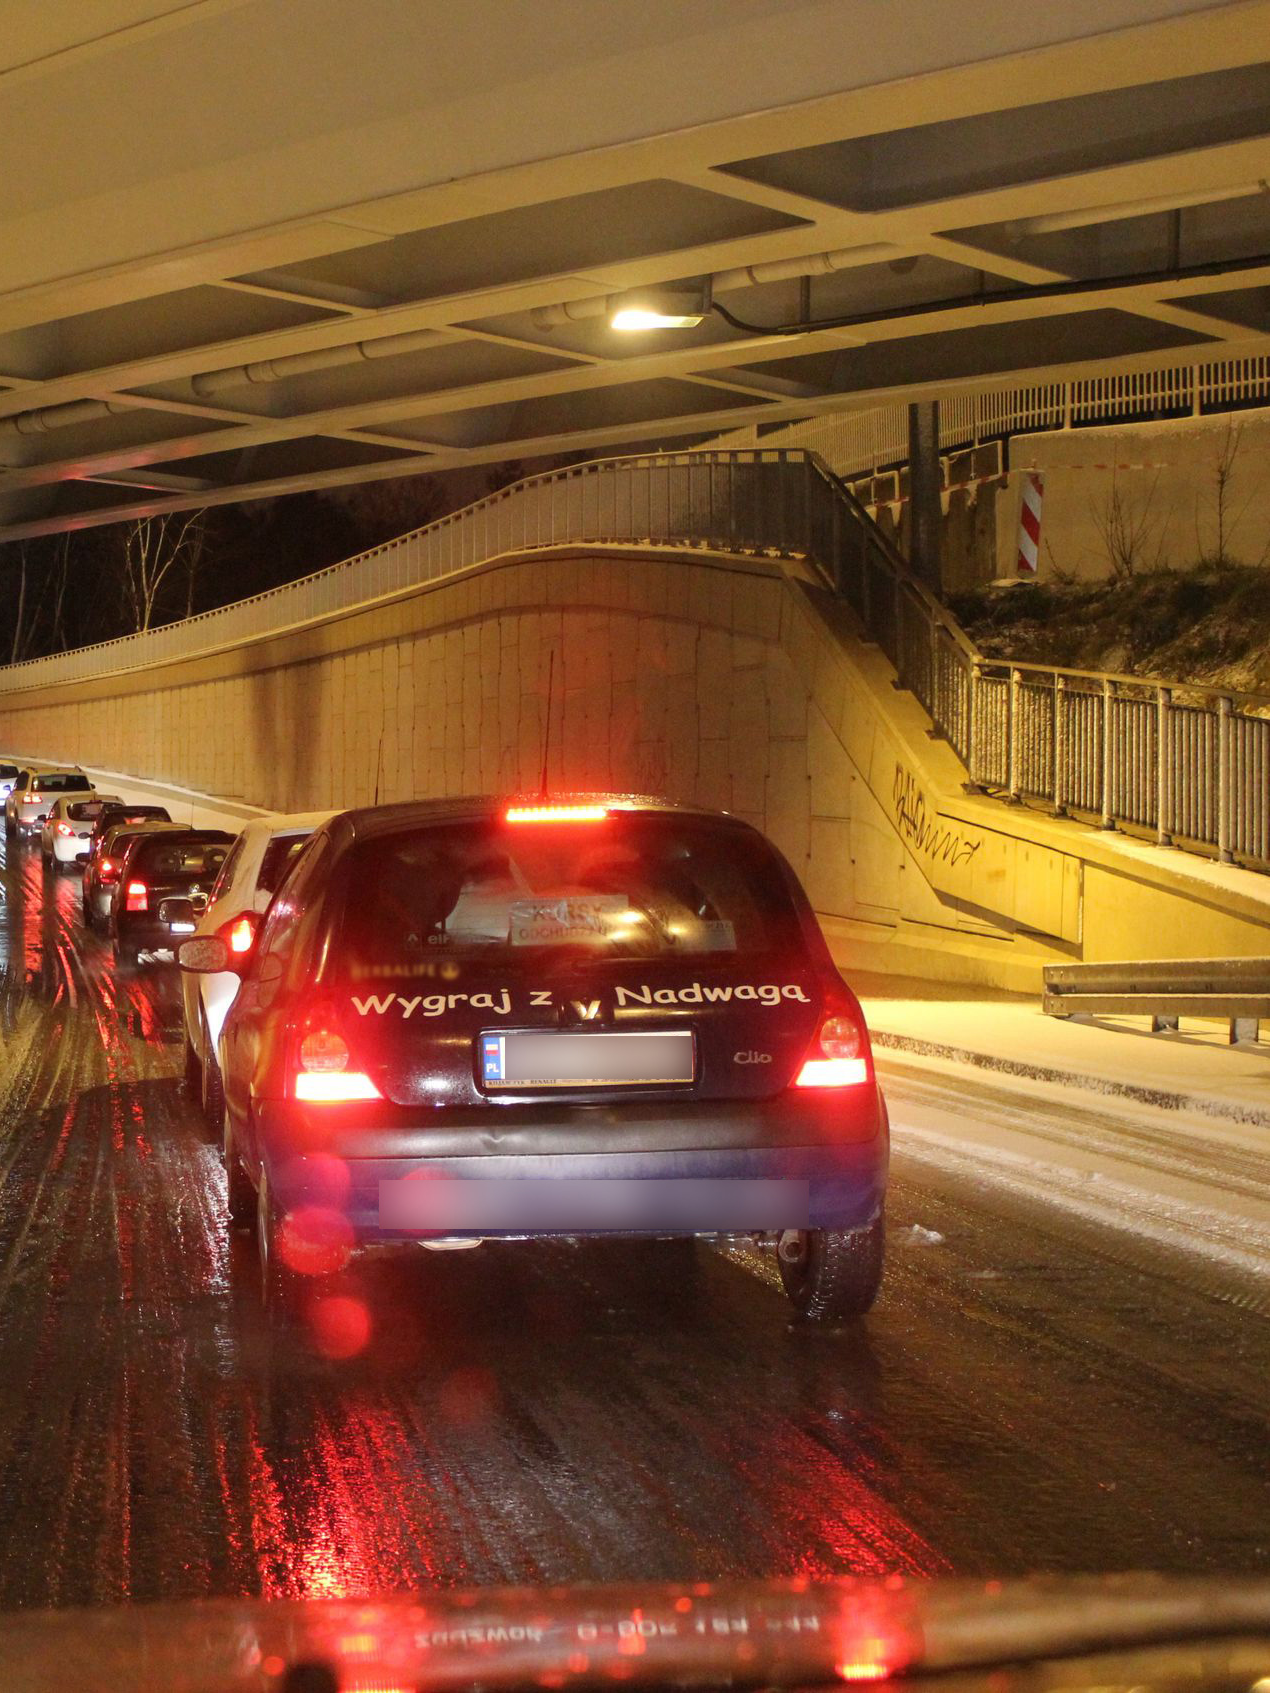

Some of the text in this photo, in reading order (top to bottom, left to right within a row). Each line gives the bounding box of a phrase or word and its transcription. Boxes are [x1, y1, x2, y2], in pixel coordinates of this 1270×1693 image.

[533, 904, 603, 921] KRSY
[351, 988, 512, 1019] Wygraj
[529, 991, 553, 1005] z
[733, 1050, 772, 1064] Clio
[486, 1062, 499, 1073] PL
